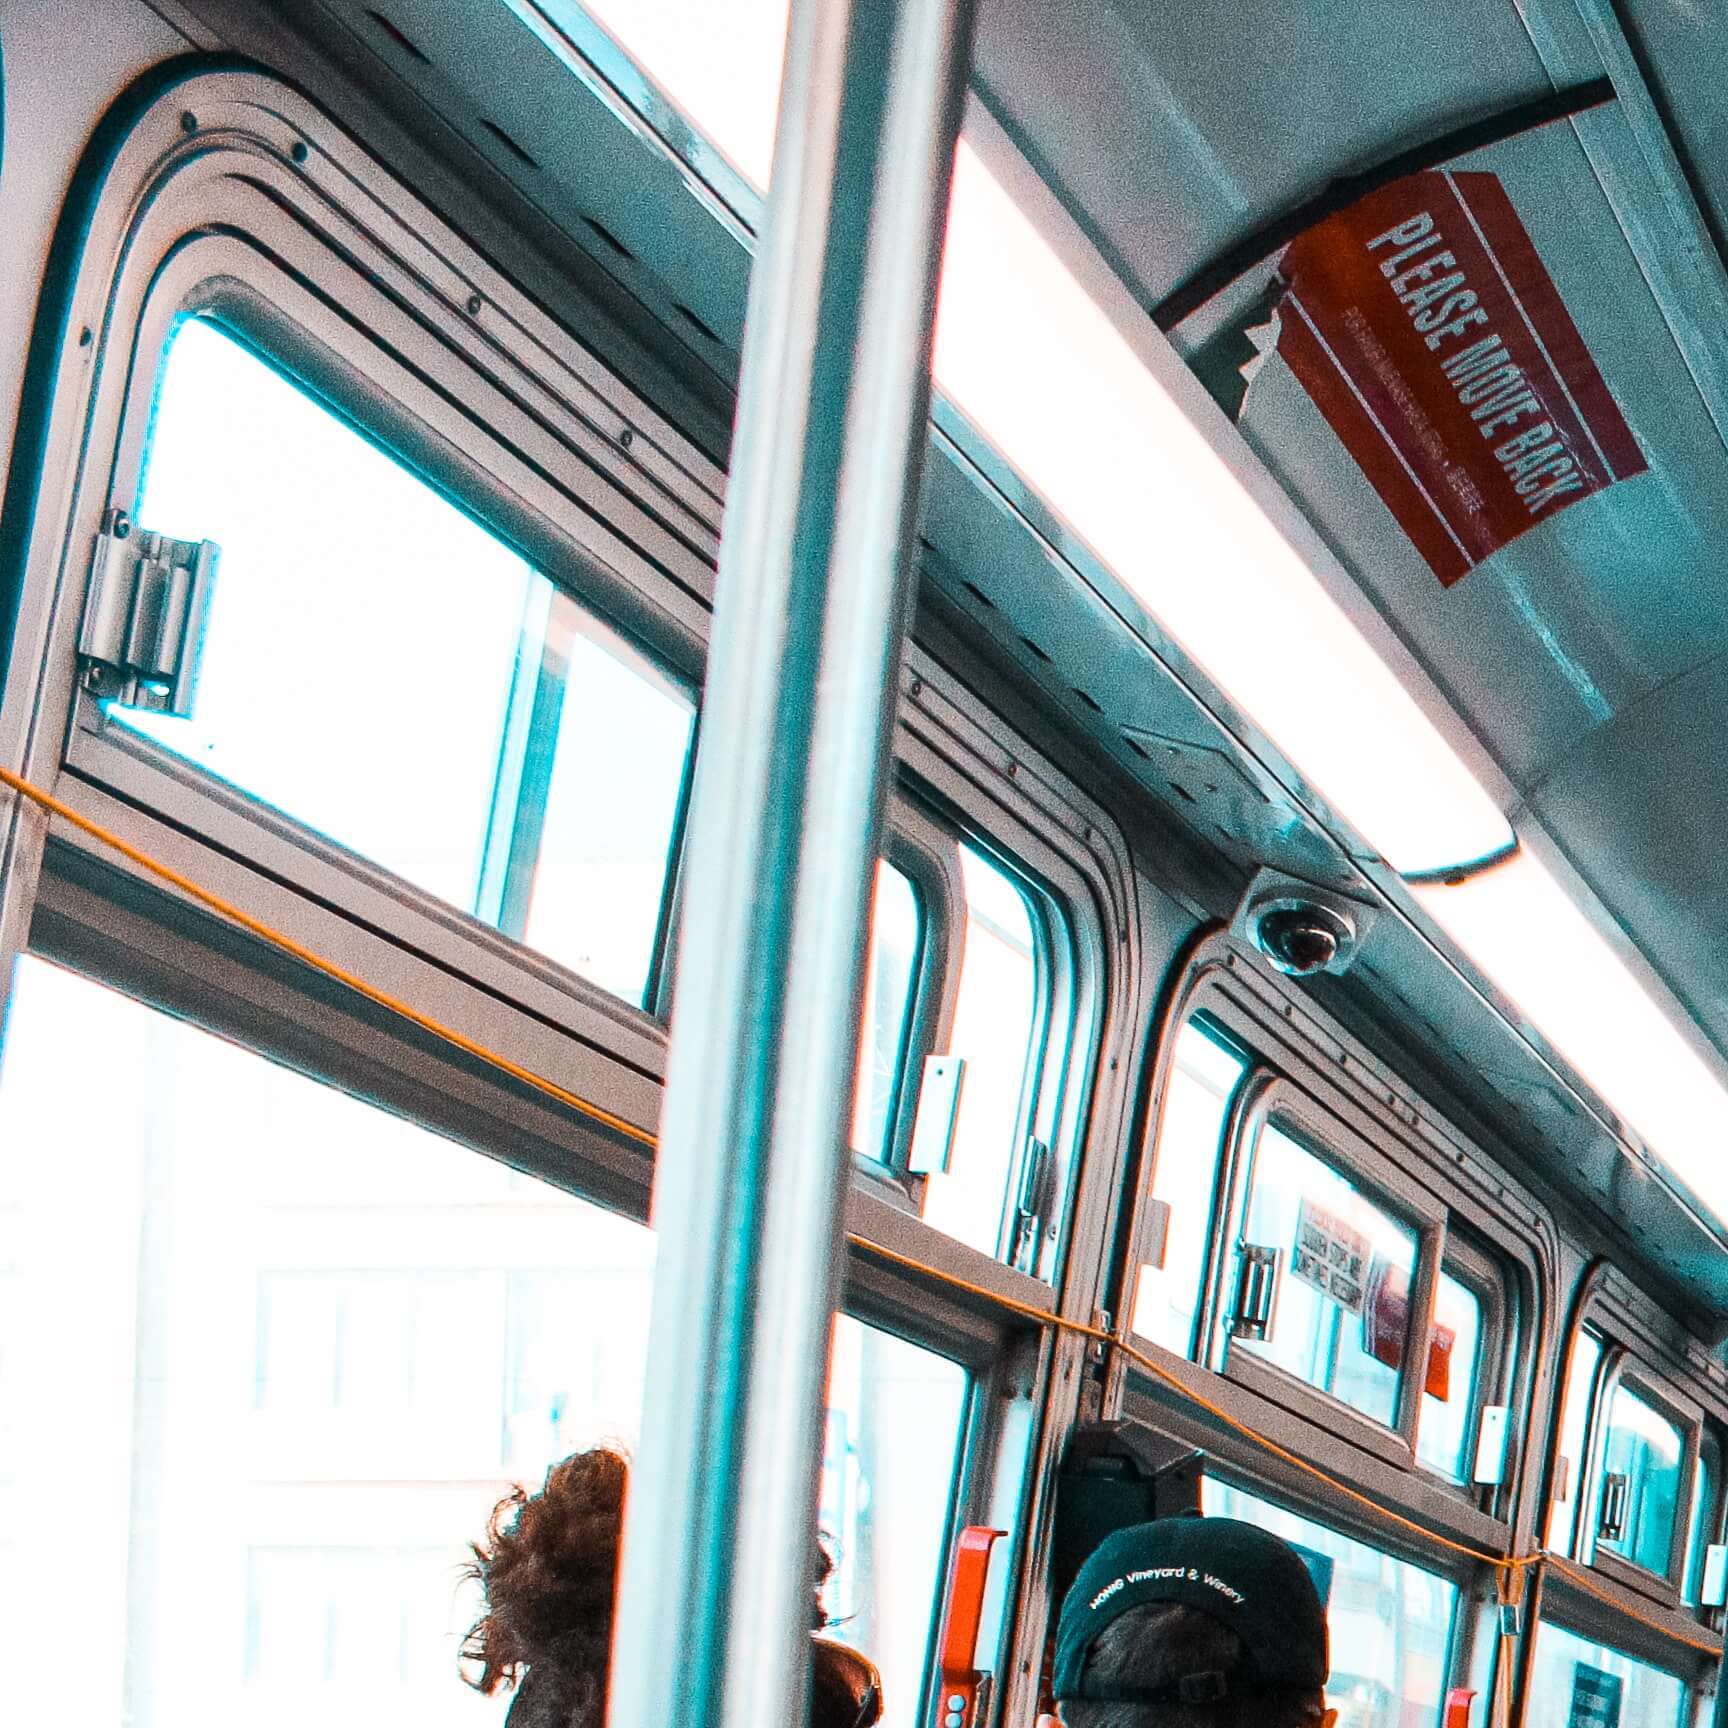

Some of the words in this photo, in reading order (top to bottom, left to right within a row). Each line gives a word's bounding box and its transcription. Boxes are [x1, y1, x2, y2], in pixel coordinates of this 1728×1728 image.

[1368, 212, 1489, 350] PLEASE
[1441, 334, 1545, 439] MOVE
[1494, 426, 1589, 513] BACK
[1126, 1566, 1185, 1584] Vineyard
[1187, 1568, 1199, 1581] &
[1203, 1573, 1245, 1604] Winery
